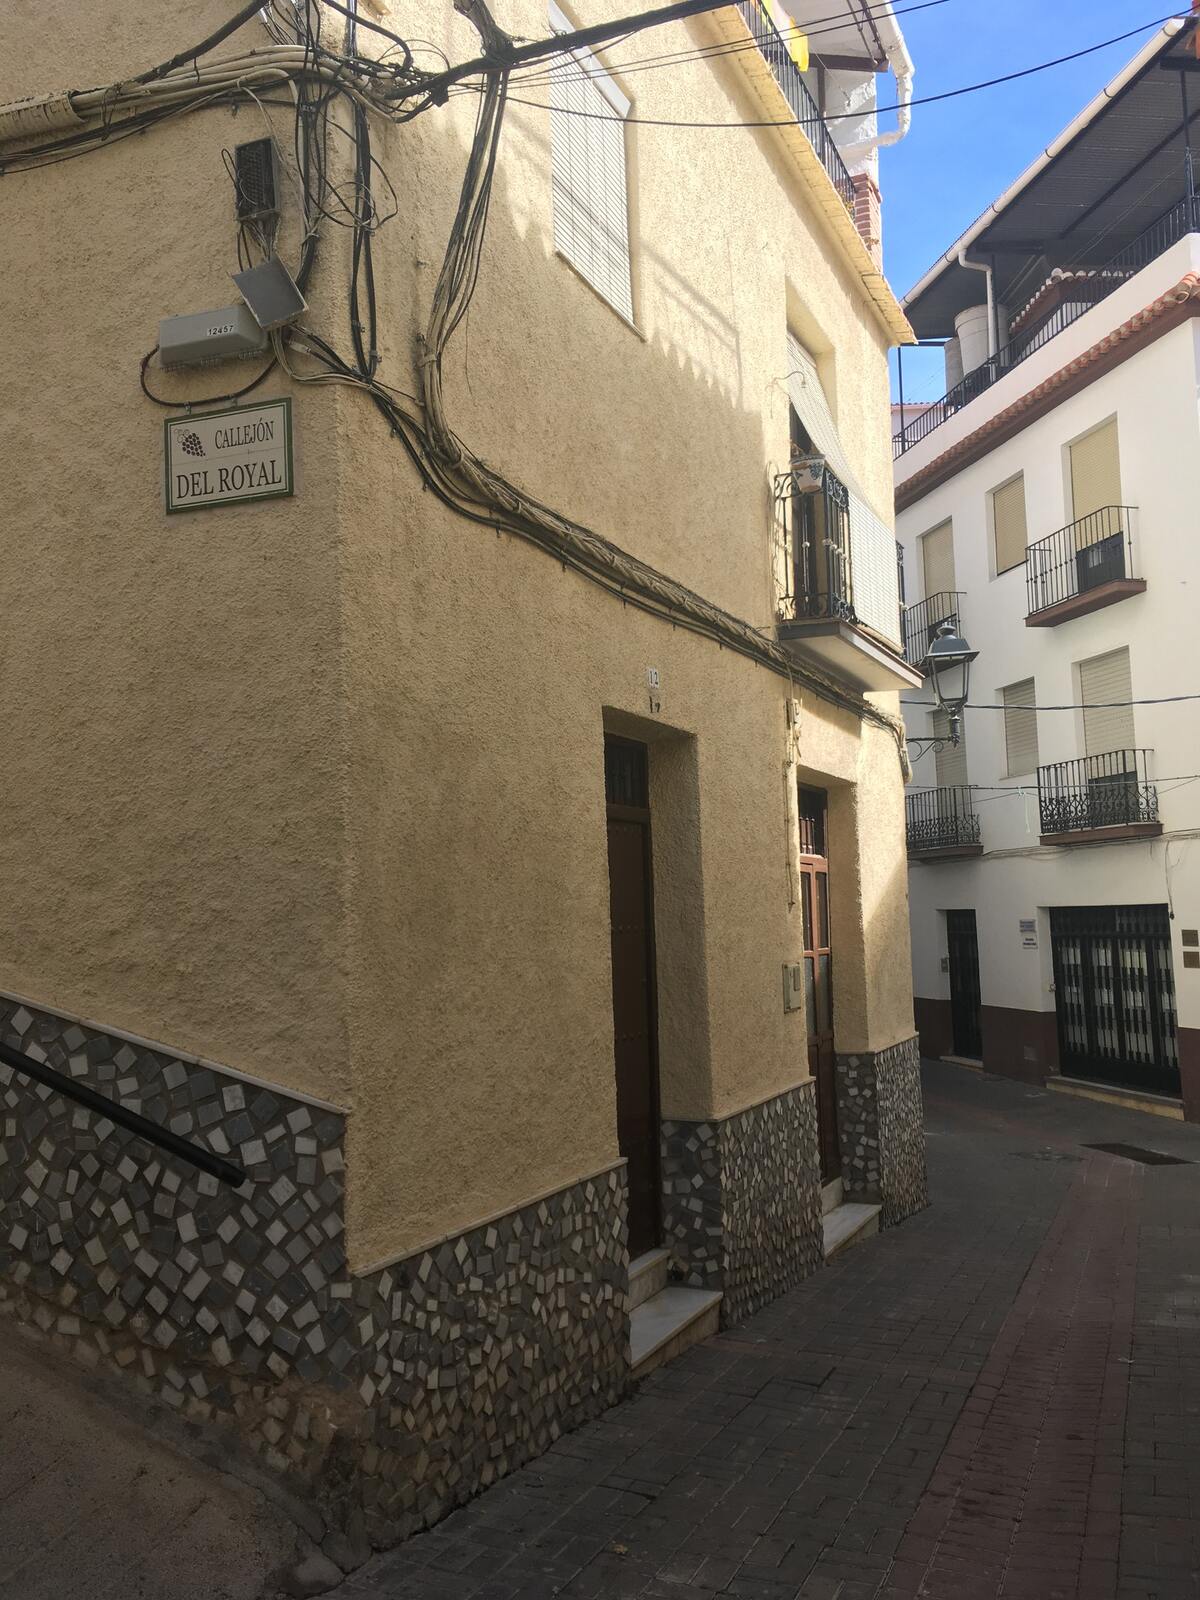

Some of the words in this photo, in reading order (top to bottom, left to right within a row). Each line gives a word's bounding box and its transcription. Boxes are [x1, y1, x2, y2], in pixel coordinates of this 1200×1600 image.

[207, 325, 235, 336] 12457
[214, 417, 275, 450] CALLEJÓN
[176, 471, 214, 499] DEL
[218, 459, 282, 493] ROYAL
